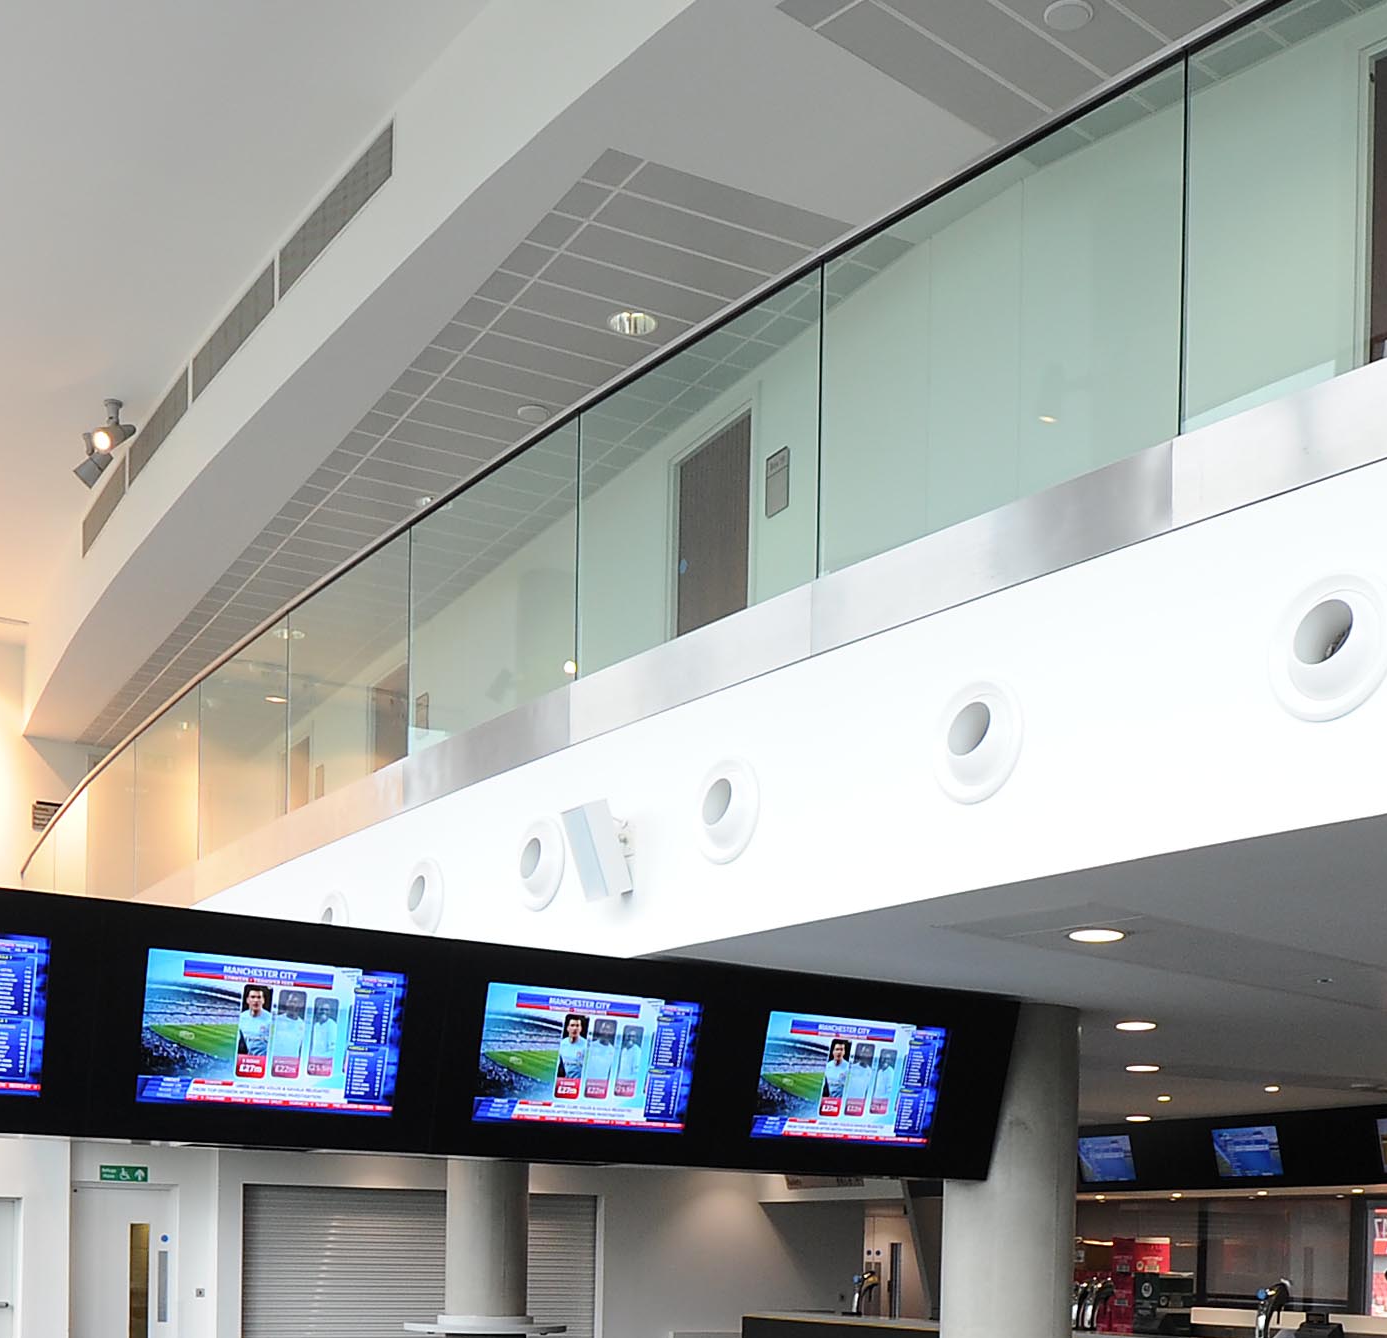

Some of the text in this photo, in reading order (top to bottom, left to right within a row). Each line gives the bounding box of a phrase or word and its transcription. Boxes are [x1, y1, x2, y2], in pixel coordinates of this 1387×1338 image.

[223, 965, 298, 980] MANCHESTER CITY
[549, 997, 611, 1009] MANCHESTER CITY
